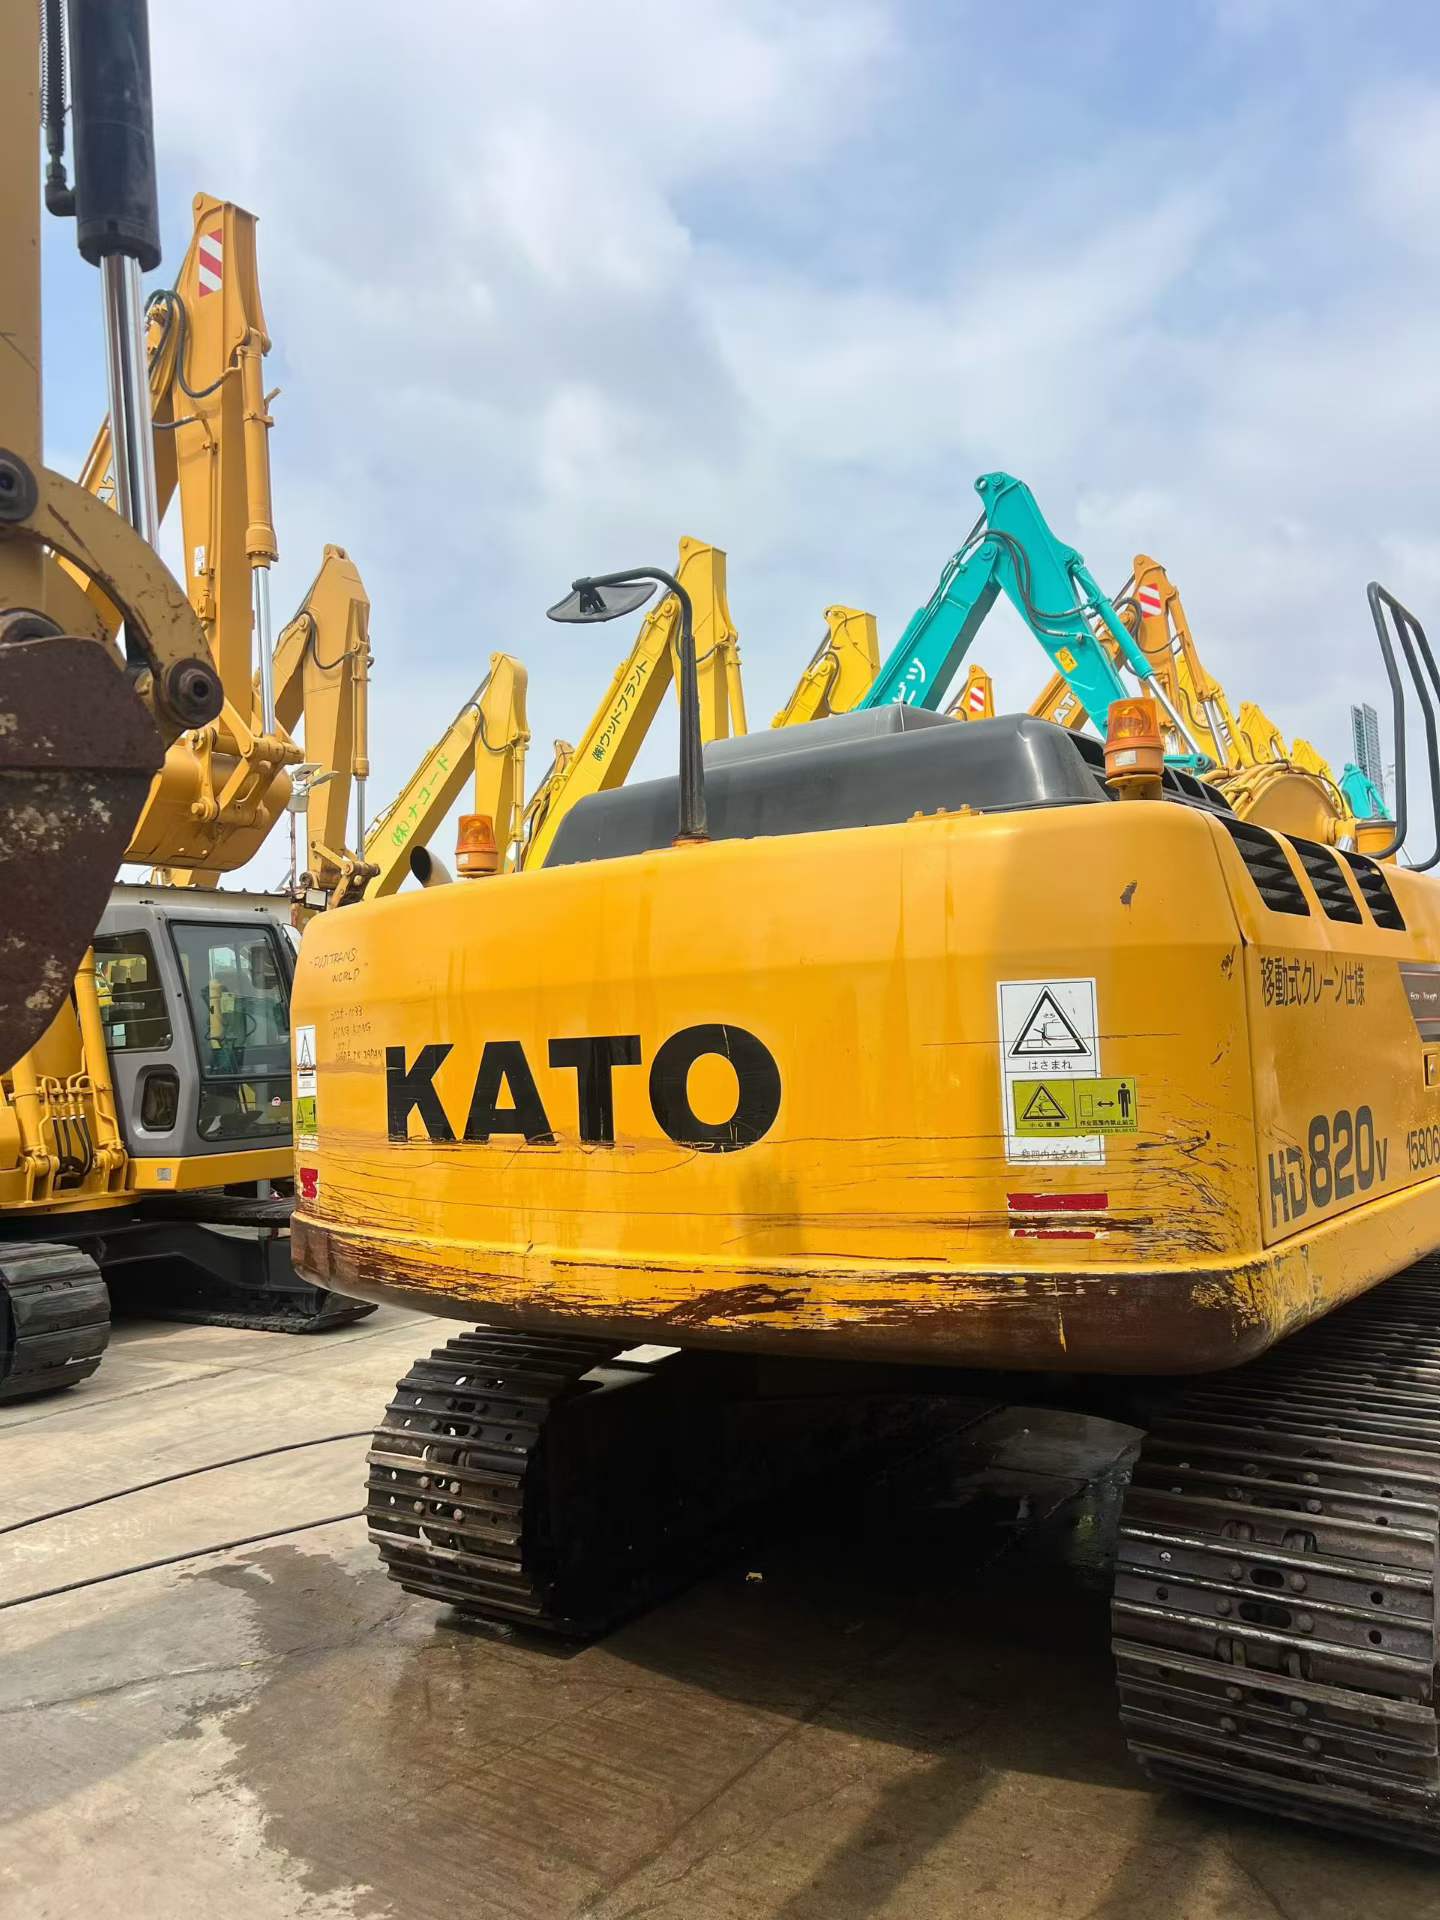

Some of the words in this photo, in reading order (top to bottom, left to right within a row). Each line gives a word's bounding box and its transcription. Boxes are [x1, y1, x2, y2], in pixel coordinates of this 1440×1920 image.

[1260, 956, 1366, 1008] 移動式クレーン仕様
[385, 1023, 782, 1154] KATO
[1028, 1059, 1073, 1071] はさまれ
[1406, 1124, 1440, 1172] 15806
